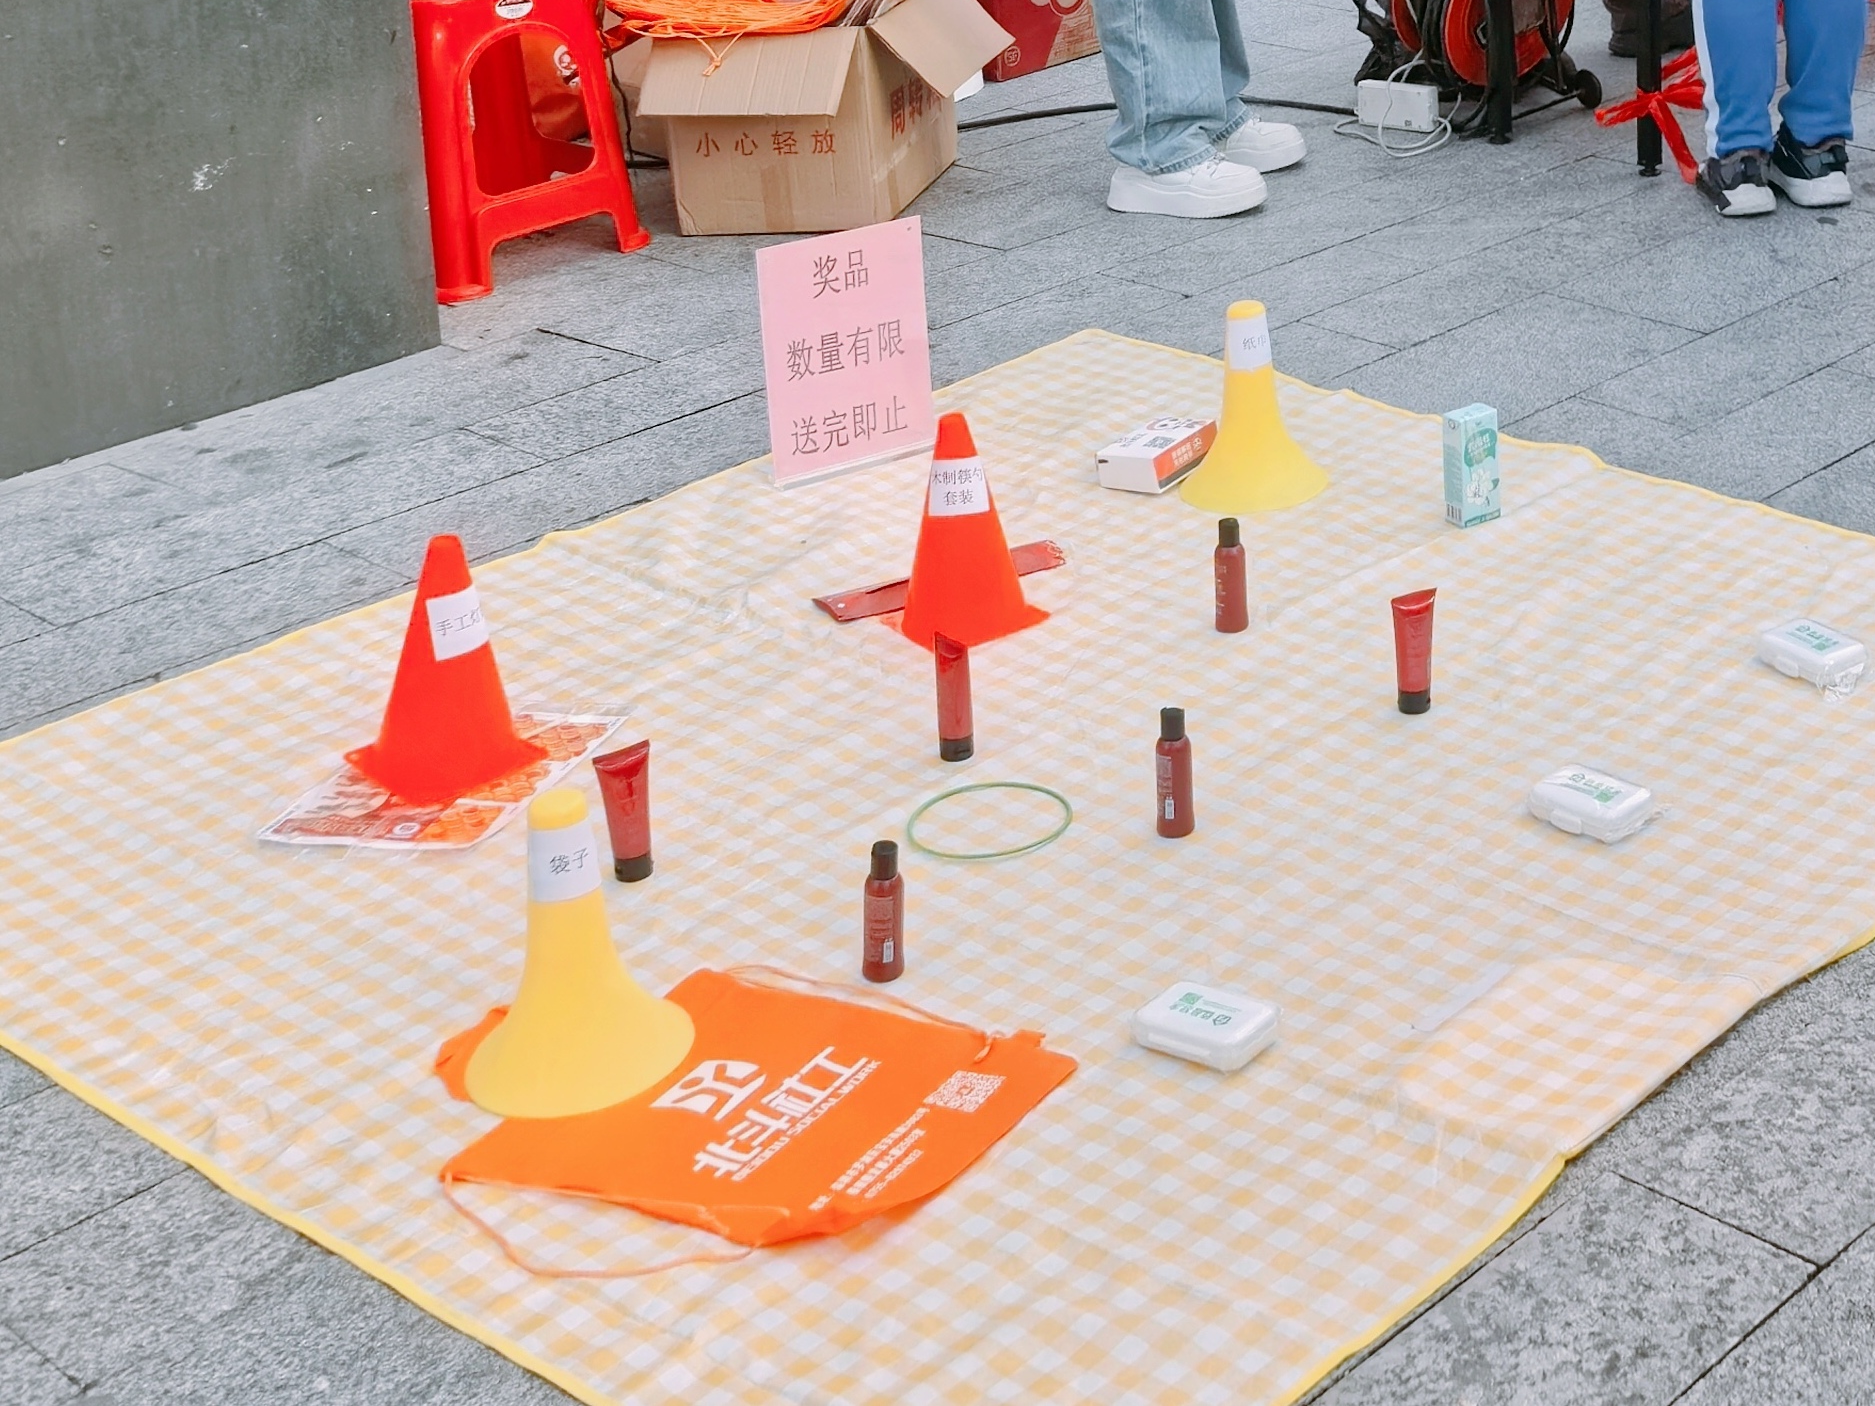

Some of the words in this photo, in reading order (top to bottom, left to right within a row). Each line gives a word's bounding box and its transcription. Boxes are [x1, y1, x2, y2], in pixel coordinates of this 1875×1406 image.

[695, 129, 837, 157] 小心轻放
[812, 249, 870, 299] 奖品
[786, 318, 905, 382] 数量有限
[1242, 334, 1267, 350] 纸巾
[790, 395, 909, 457] 送完即止
[943, 488, 975, 506] 套装
[548, 847, 590, 876] 袋子
[691, 1045, 869, 1180] 北斗社工
[786, 1097, 837, 1137] SOCIAL
[838, 1058, 883, 1100] WORK
